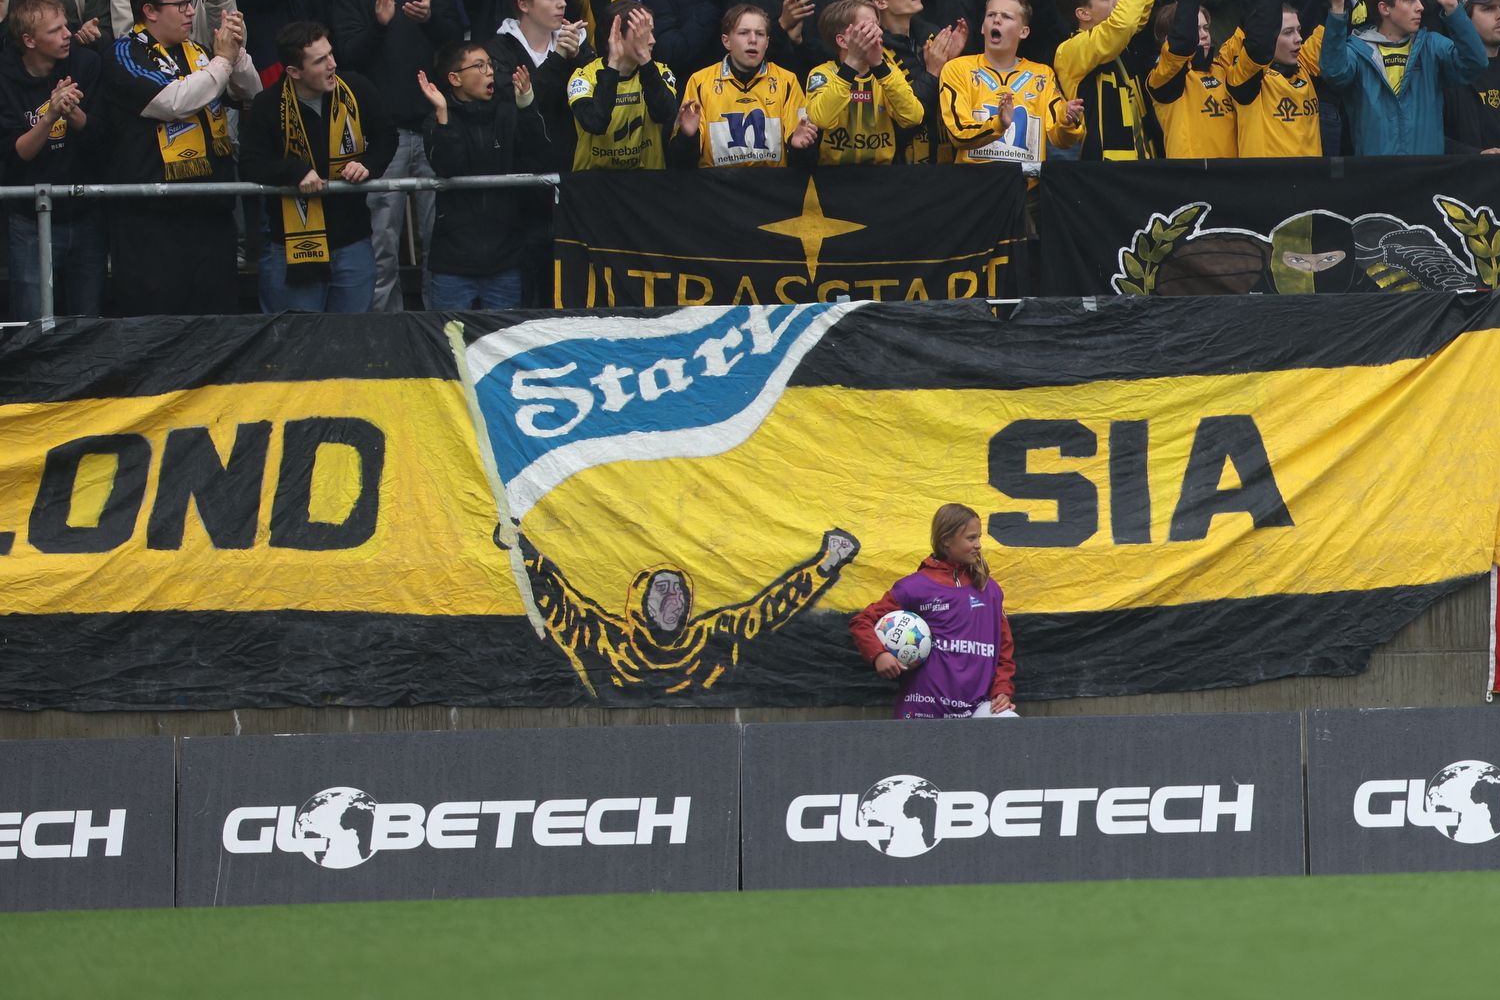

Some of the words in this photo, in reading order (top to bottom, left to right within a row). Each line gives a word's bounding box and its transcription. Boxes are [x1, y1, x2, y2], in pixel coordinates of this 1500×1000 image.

[849, 92, 871, 100] TOOLS
[853, 132, 893, 150] SØR
[0, 416, 385, 554] OND
[987, 415, 1294, 548] SIA
[890, 615, 911, 645] SELECT
[904, 692, 936, 704] altibox
